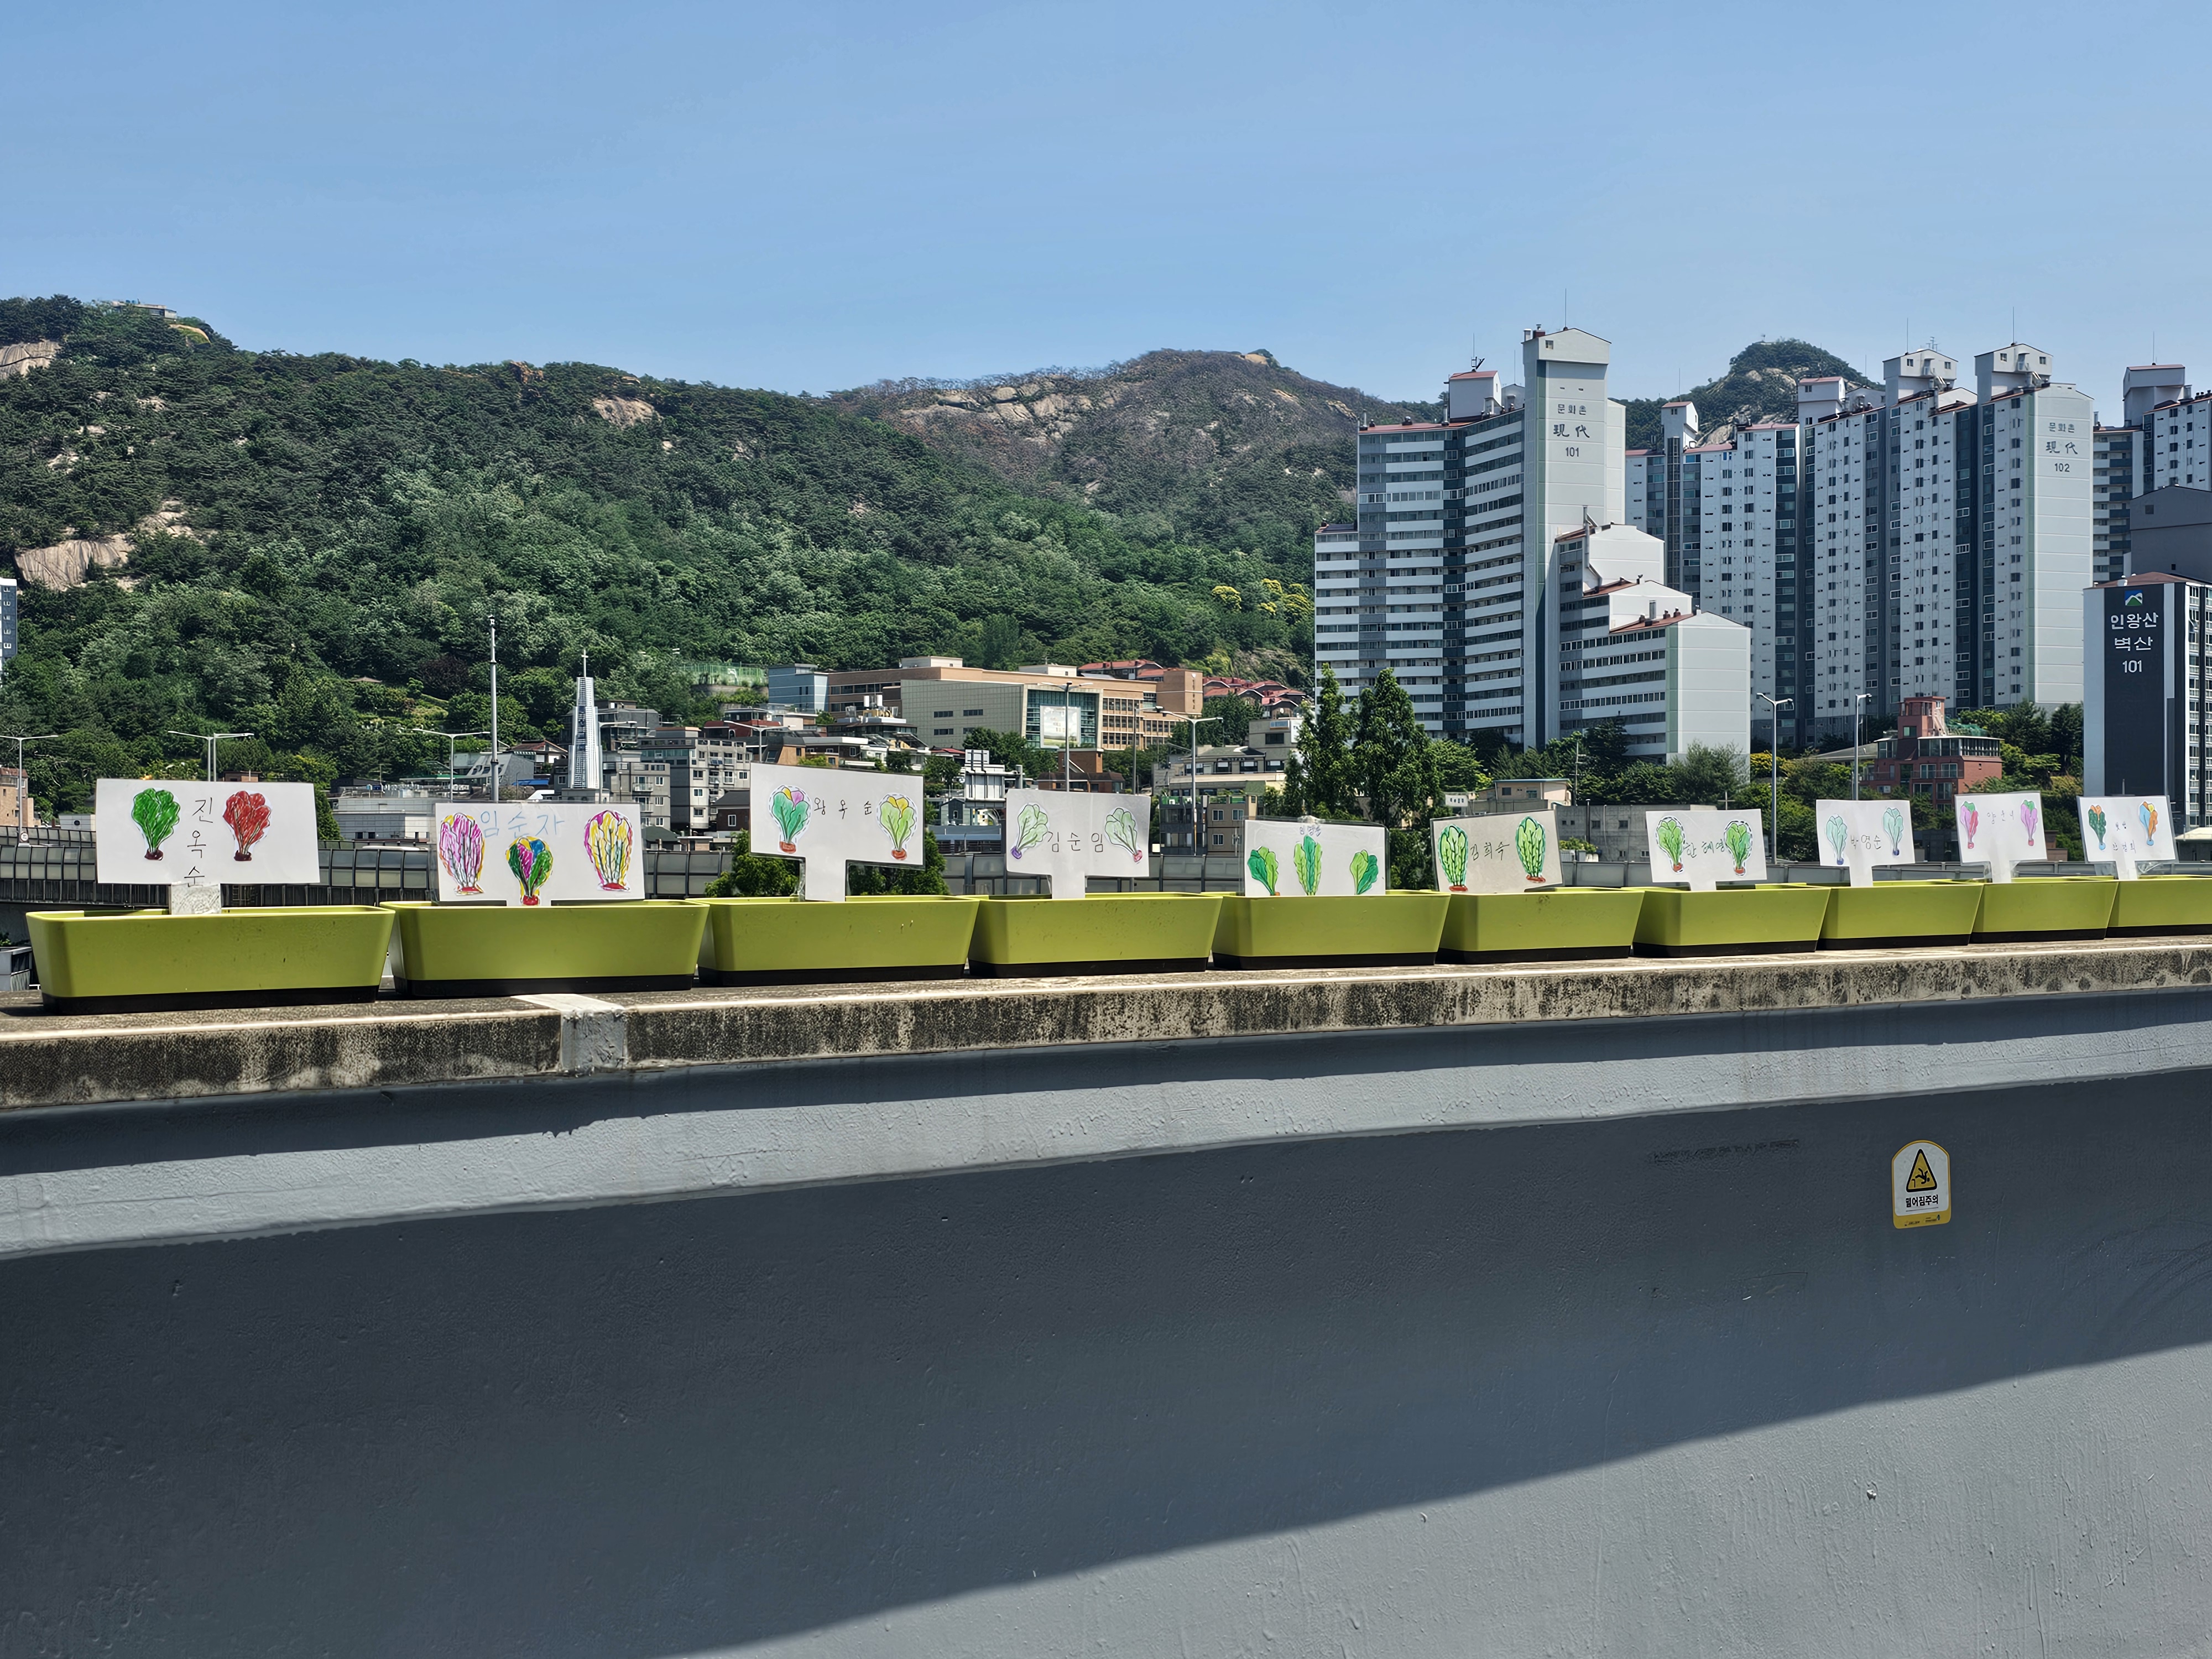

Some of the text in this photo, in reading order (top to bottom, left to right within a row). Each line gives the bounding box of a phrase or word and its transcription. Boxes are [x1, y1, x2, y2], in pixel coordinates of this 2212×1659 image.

[1566, 447, 1579, 457] 101
[2054, 463, 2070, 472] 102
[2110, 612, 2159, 630] 인왕산
[2114, 637, 2153, 651] 벽산
[2122, 660, 2142, 673] 101
[480, 810, 565, 838] 임순자
[1047, 831, 1104, 853] 김순임
